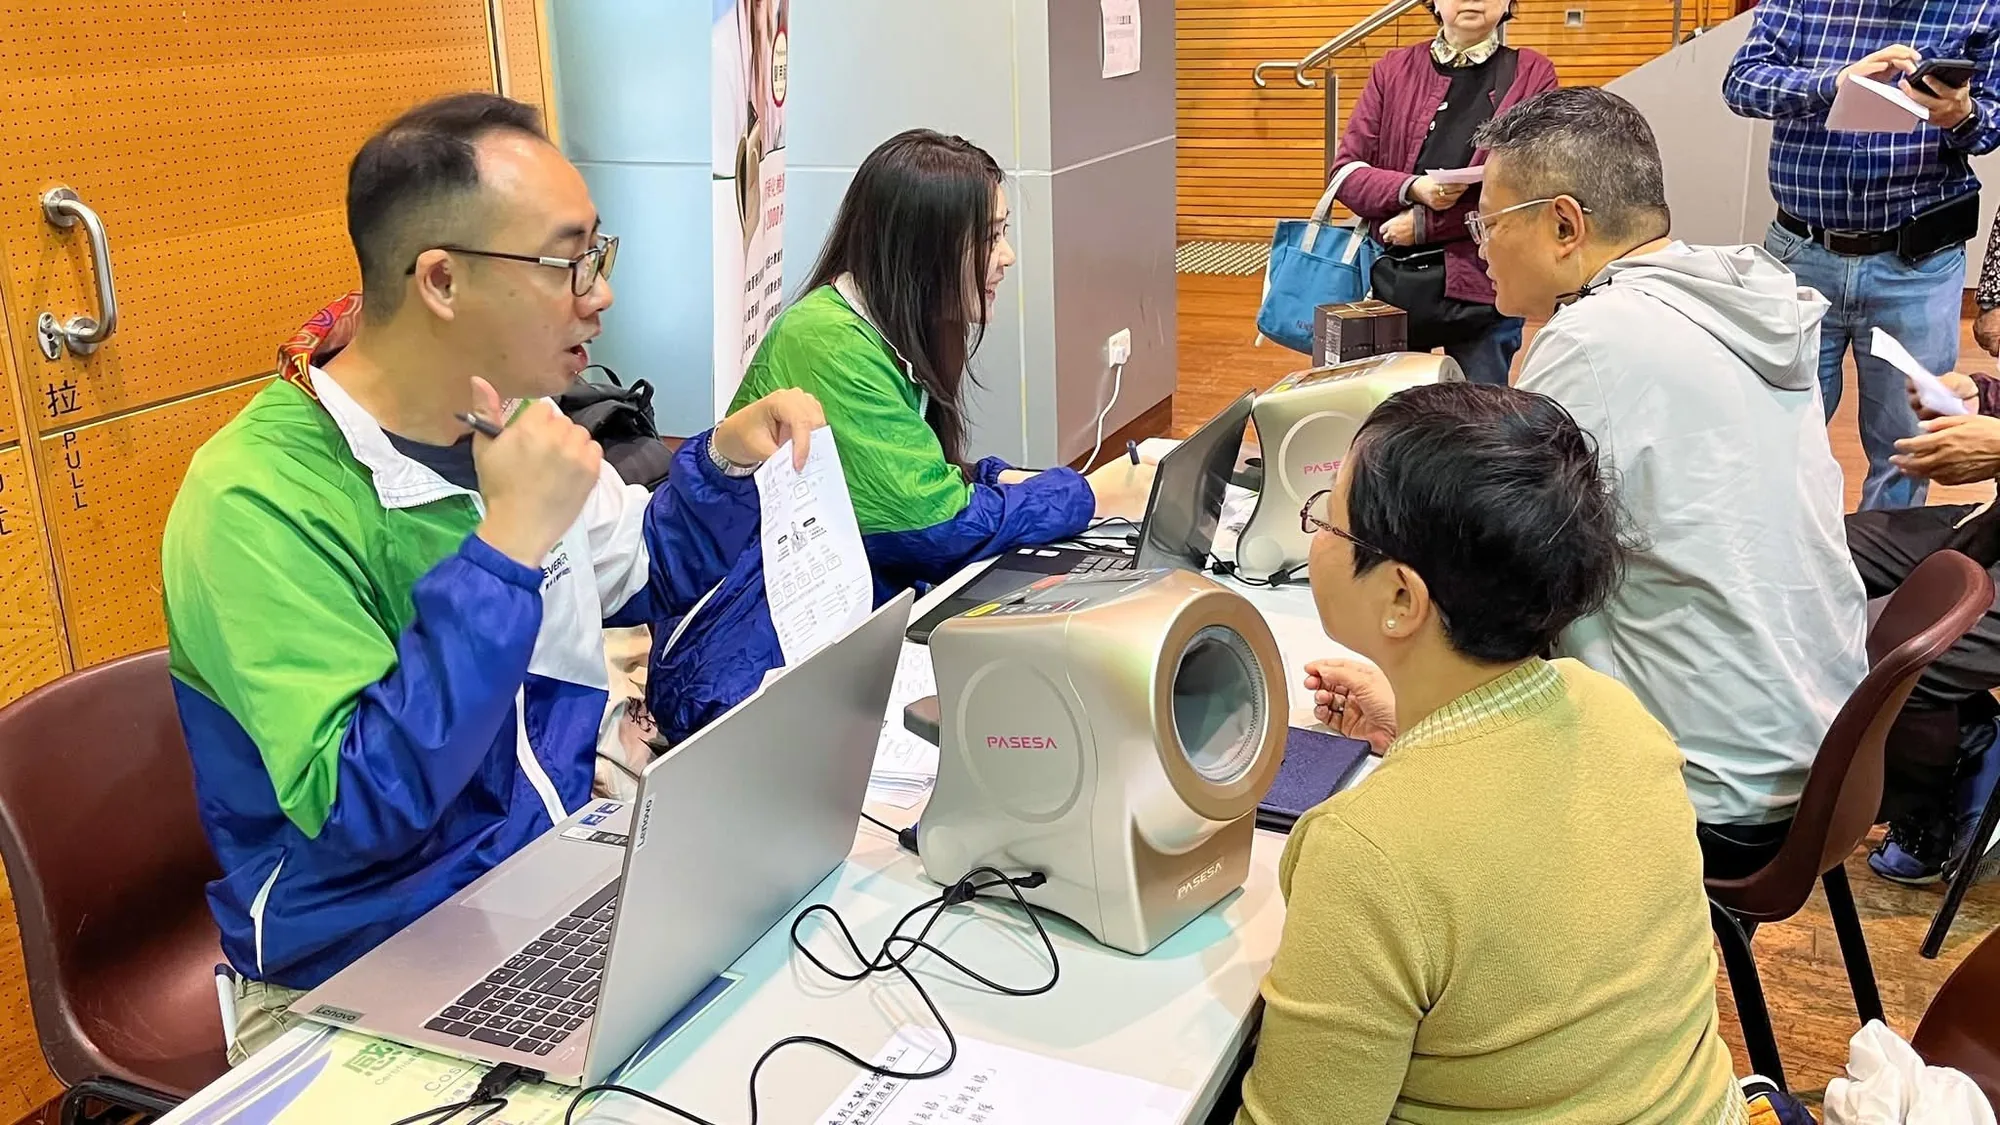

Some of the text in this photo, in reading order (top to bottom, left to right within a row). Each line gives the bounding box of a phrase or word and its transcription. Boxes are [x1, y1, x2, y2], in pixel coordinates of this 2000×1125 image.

[46, 380, 82, 417] 拉
[63, 431, 88, 509] PULL
[986, 736, 1058, 749] PASESA
[637, 799, 653, 848] Lenovo
[1177, 862, 1222, 898] PASESA
[315, 1006, 356, 1021] Lenovo
